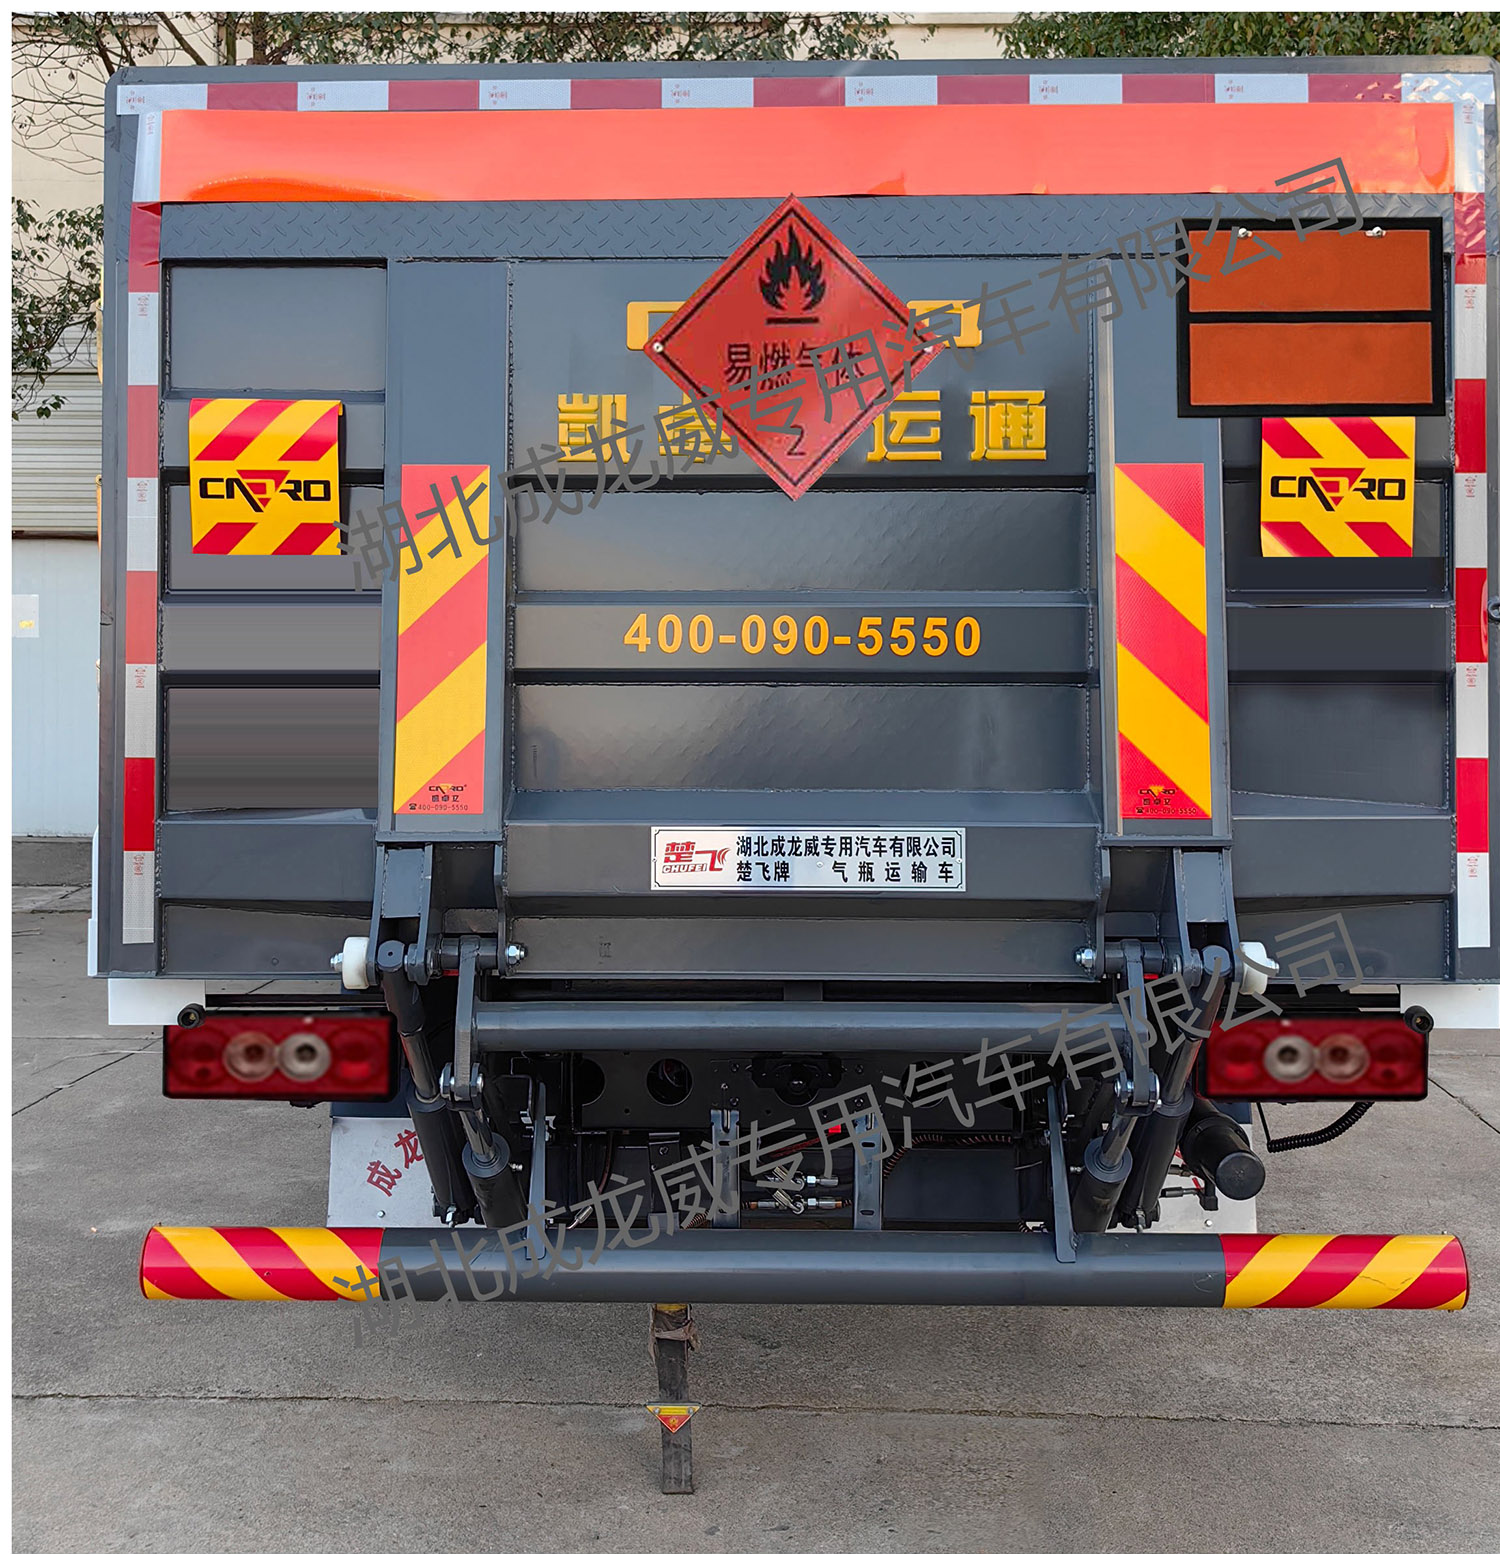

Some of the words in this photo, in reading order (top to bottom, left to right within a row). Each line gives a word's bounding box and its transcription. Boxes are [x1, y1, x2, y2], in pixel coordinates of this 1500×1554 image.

[786, 424, 808, 458] 2
[623, 613, 982, 657] 400-090-5550
[736, 835, 956, 858] 湖北成龙威专用汽车有限公司
[662, 863, 707, 873] CHUFEI
[736, 861, 791, 882] 楚飞牌
